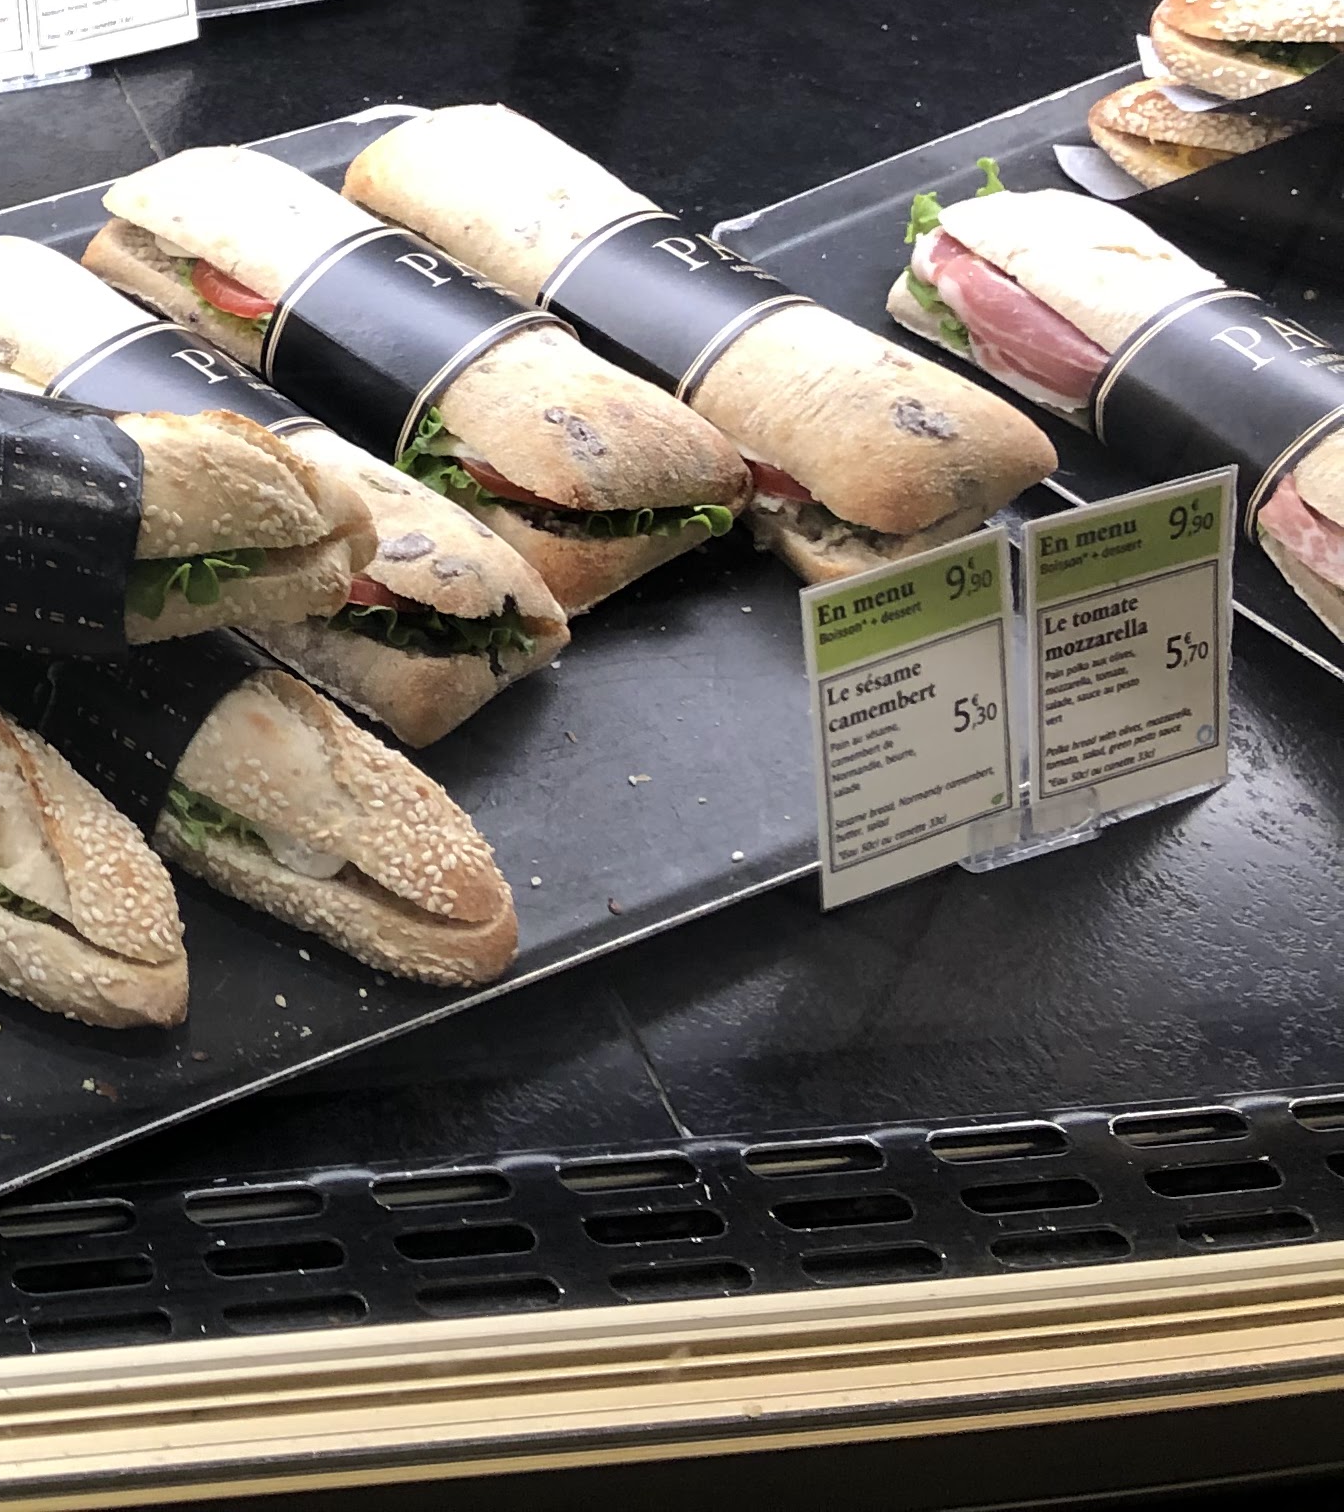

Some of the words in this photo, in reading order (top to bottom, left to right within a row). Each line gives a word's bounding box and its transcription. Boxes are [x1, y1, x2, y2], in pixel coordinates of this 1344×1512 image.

[651, 233, 753, 272] PA
[1210, 316, 1332, 371] PA
[1039, 534, 1069, 558] En
[1075, 515, 1137, 549] menu
[817, 605, 846, 628] En
[853, 580, 915, 615] menu
[1045, 614, 1067, 636] Le
[1072, 596, 1138, 627] tomate
[1045, 616, 1148, 662] mozzarella
[826, 685, 850, 707] Le
[856, 659, 923, 697] sésame
[828, 683, 936, 733] camembert
